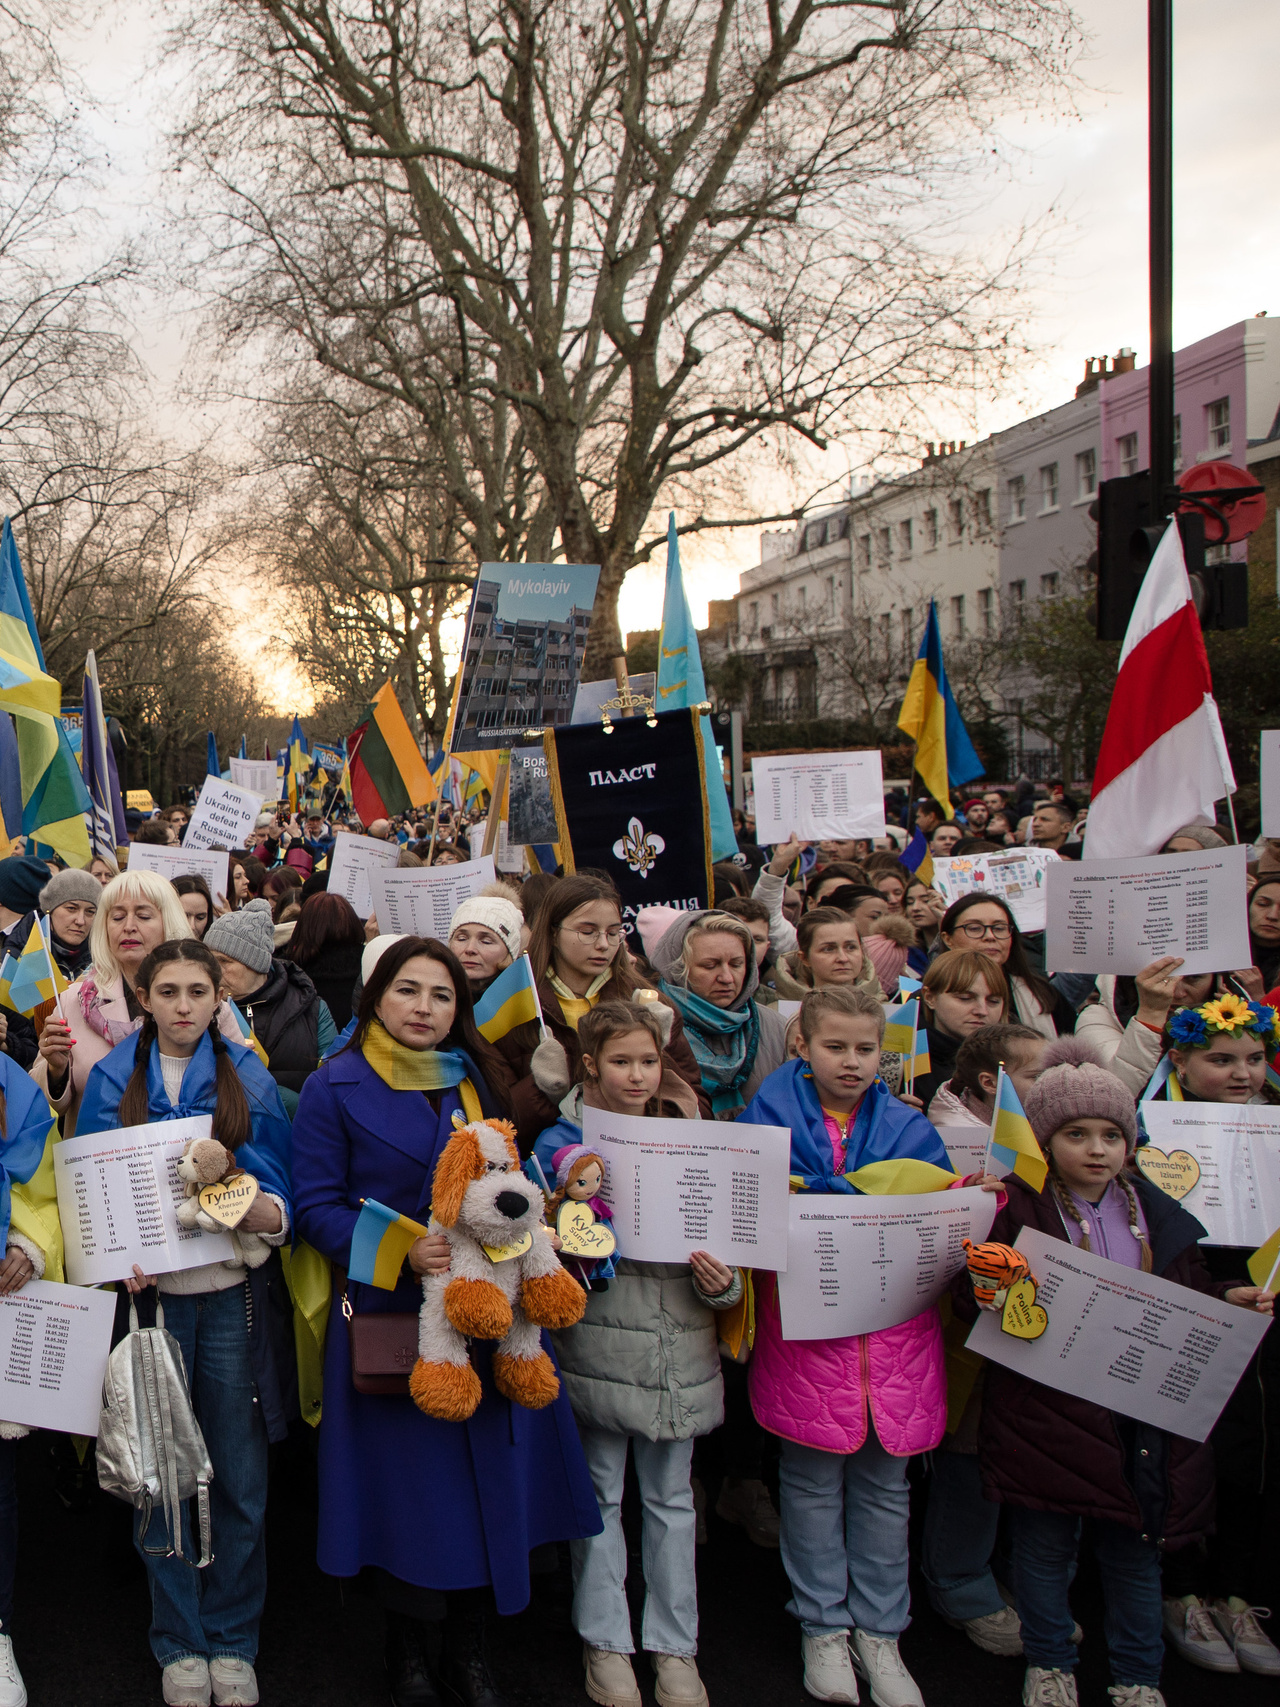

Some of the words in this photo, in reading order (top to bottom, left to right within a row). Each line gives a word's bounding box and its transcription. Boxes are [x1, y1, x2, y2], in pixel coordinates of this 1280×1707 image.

[508, 578, 570, 597] Mykolayiv
[320, 752, 337, 766] 365
[588, 763, 656, 786] ПЛАСТ
[222, 790, 242, 804] Arm
[205, 796, 239, 816] Ukraine
[242, 811, 250, 820] to
[210, 812, 238, 829] defeat
[200, 821, 238, 842] Russian
[127, 1160, 152, 1169] Mariupol
[1141, 1159, 1192, 1172] Artemchyk
[205, 1186, 251, 1205] Tymur
[218, 1201, 243, 1210] Kherson
[569, 1227, 588, 1247] Sumy
[572, 1215, 604, 1247] Kyryl
[1016, 1293, 1032, 1325] Polina
